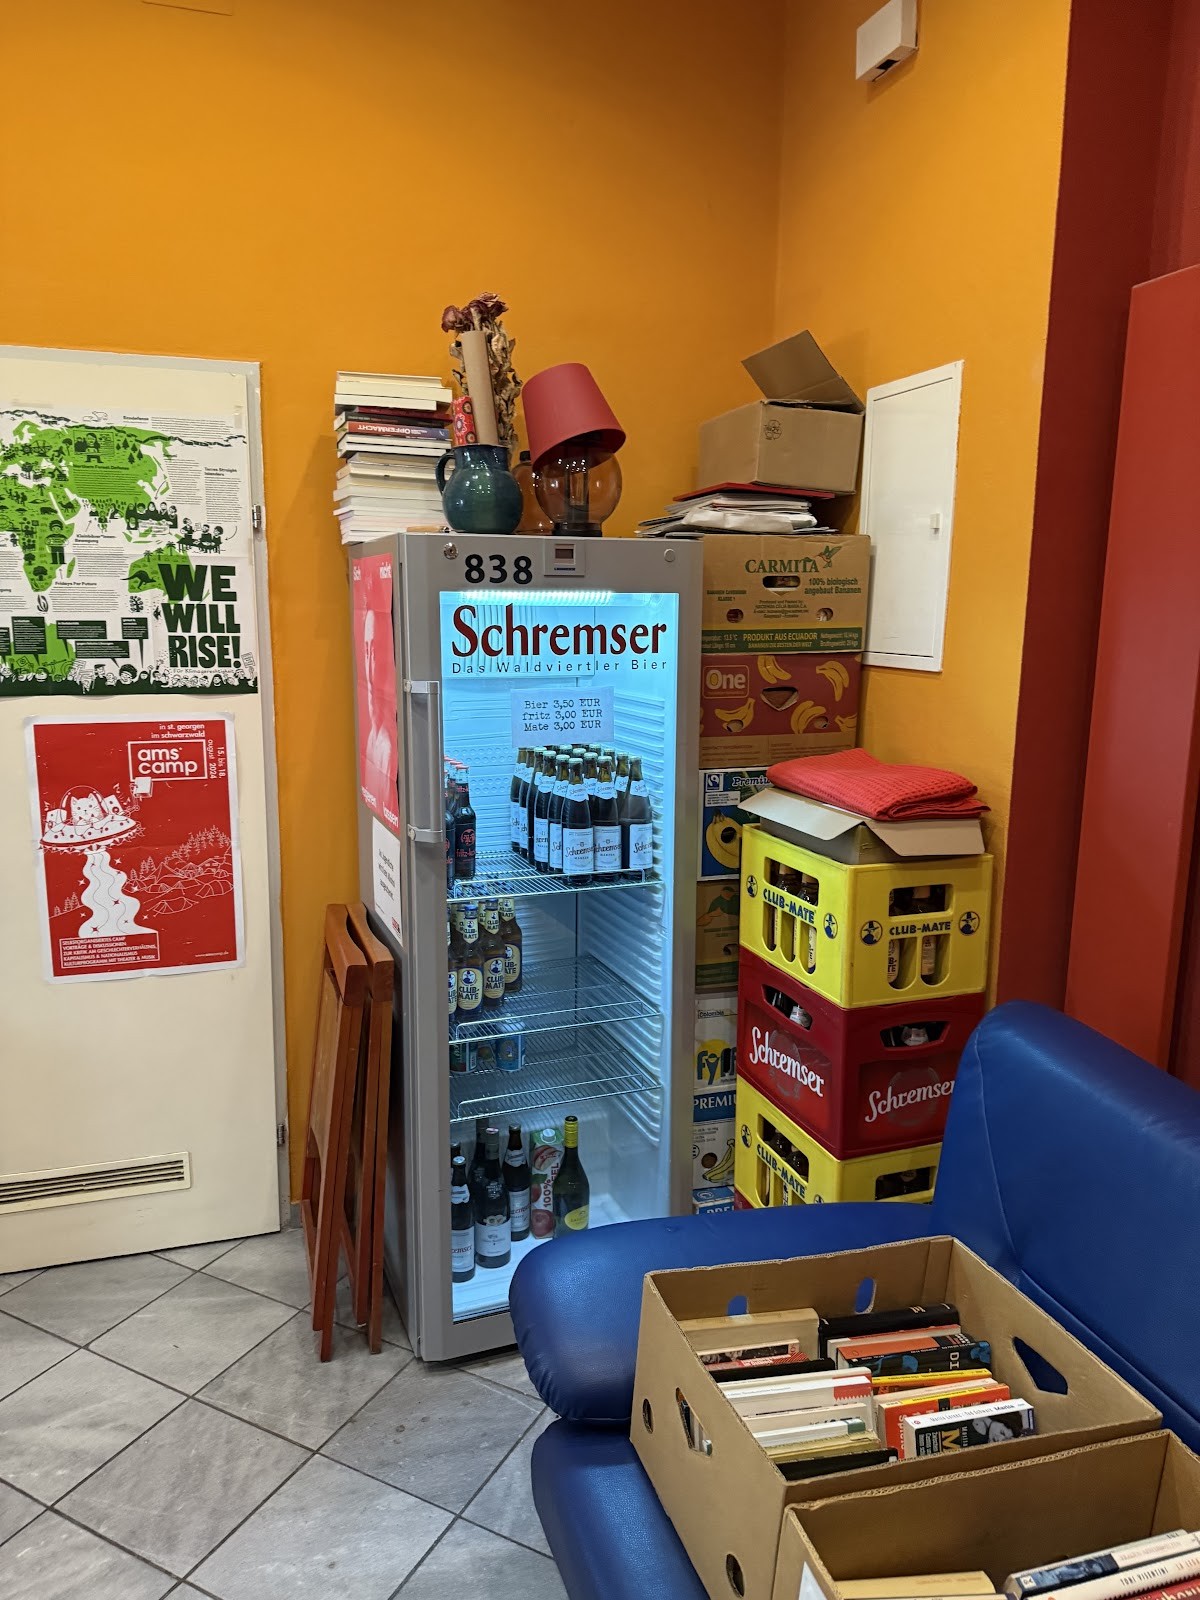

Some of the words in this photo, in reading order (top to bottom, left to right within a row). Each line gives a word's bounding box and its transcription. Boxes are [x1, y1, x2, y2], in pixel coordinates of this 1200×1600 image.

[464, 553, 533, 585] 838
[745, 557, 820, 574] CARMITA
[158, 563, 237, 602] WE
[161, 603, 240, 633] WILL
[452, 603, 667, 657] Schremser
[743, 633, 773, 642] PRODUKT
[774, 633, 787, 641] AUS
[788, 632, 818, 641] ECUADOR
[168, 635, 241, 668] RISE!
[452, 662, 485, 674] Das
[496, 660, 620, 673] Waldviertler
[631, 659, 667, 670] Bier
[706, 669, 747, 690] One
[524, 700, 549, 710] Bier
[553, 699, 575, 710] 3,50
[579, 698, 601, 707] EUR
[522, 711, 551, 721] fritz
[555, 710, 577, 720] 3,00
[582, 709, 603, 718] EUR
[177, 723, 205, 732] georgen
[523, 722, 549, 732] Mate
[553, 721, 576, 732] 3,00
[580, 719, 602, 729] EUR
[161, 730, 205, 739] schwarzwald
[138, 760, 198, 776] camp
[209, 763, 217, 779] 2024
[732, 774, 771, 787] Premiu
[763, 888, 815, 924] CLUB-MATE
[889, 921, 951, 936] CLUB-MATE
[749, 1025, 825, 1098] Schremser
[757, 1143, 806, 1199] CLUB-MATE
[543, 1179, 552, 1208] 100%
[1119, 1577, 1137, 1587] TONI
[1138, 1566, 1169, 1582] VISENTINI
